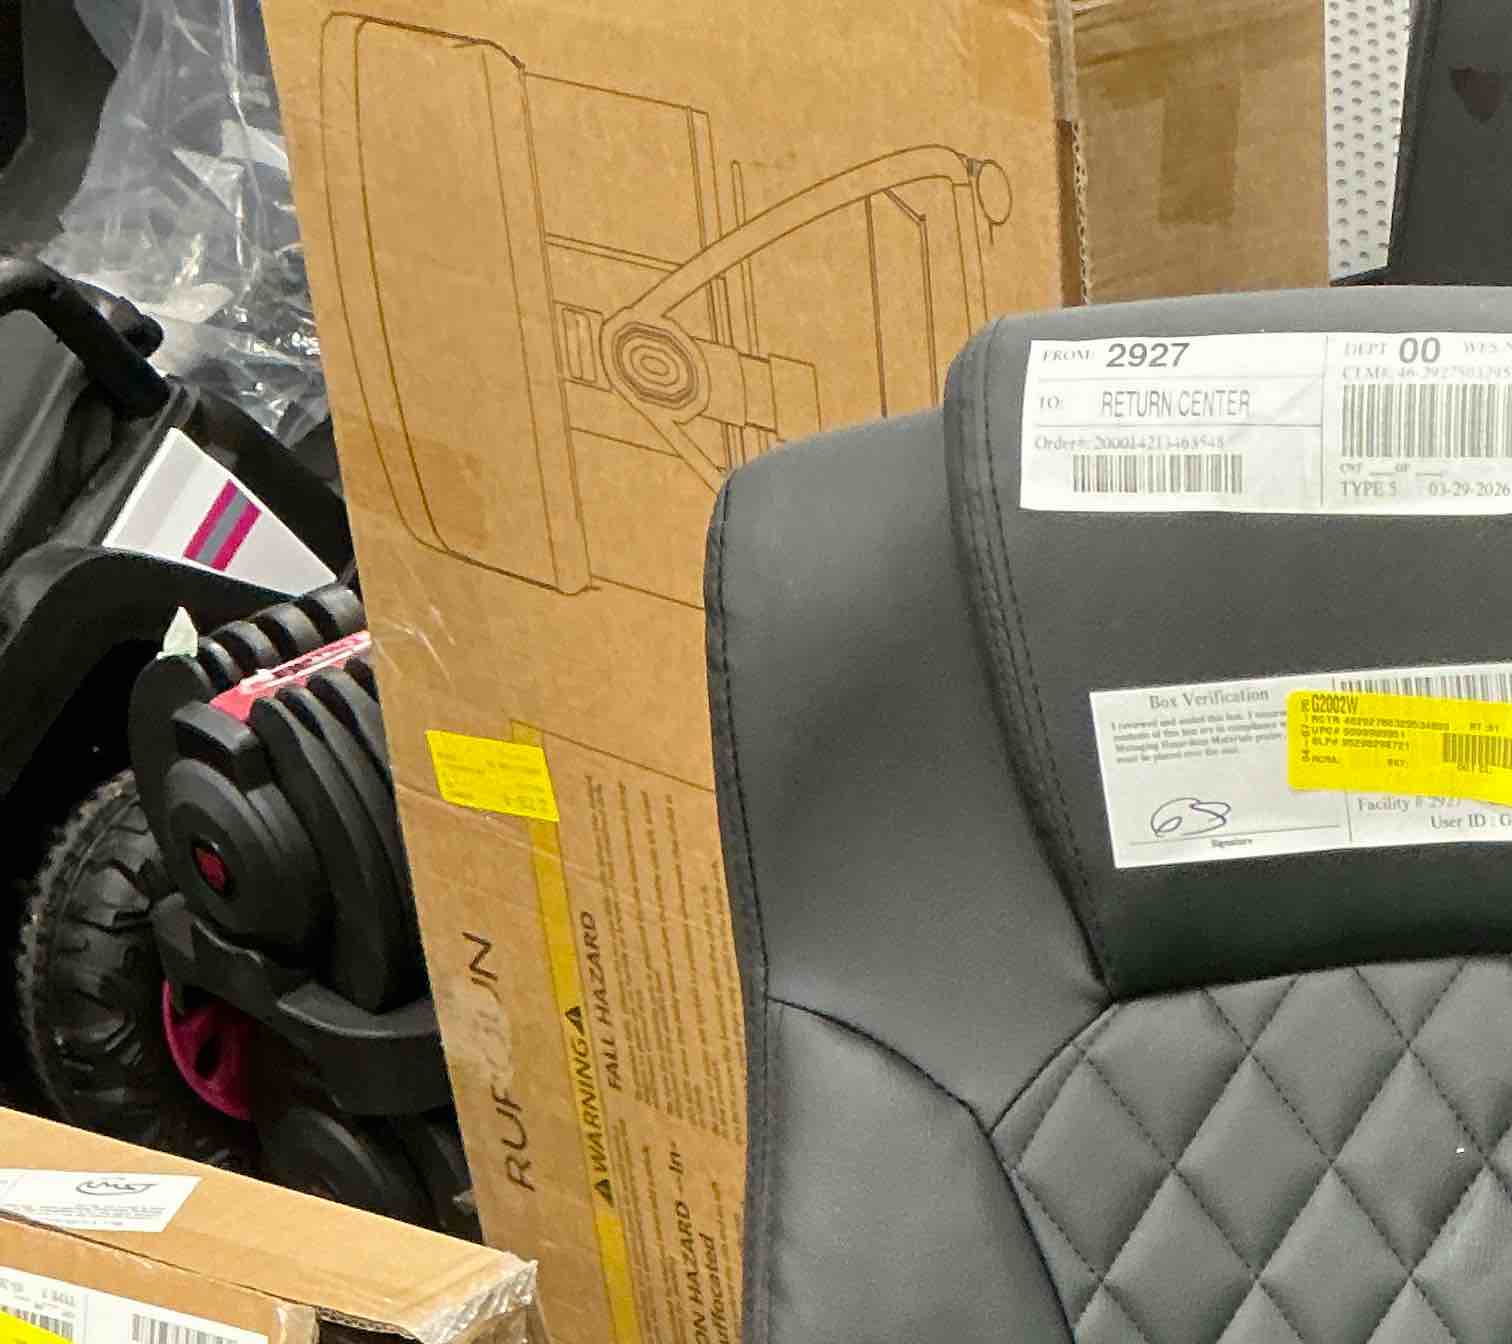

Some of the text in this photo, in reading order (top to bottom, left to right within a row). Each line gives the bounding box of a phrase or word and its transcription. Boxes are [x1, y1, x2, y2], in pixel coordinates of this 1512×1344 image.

[1106, 342, 1190, 368] 2927
[1399, 337, 1440, 363] 00
[1101, 389, 1251, 418] RETURN CENTER
[1340, 481, 1384, 497] TYPE
[1427, 481, 1511, 497] 03-29-2026
[1149, 688, 1269, 710] Box Verification
[1357, 797, 1410, 812] Facility
[1430, 815, 1462, 830] User
[580, 910, 623, 1092] FALL HAZARD
[570, 1037, 609, 1173] WARNING
[675, 1199, 704, 1305] HAZARD
